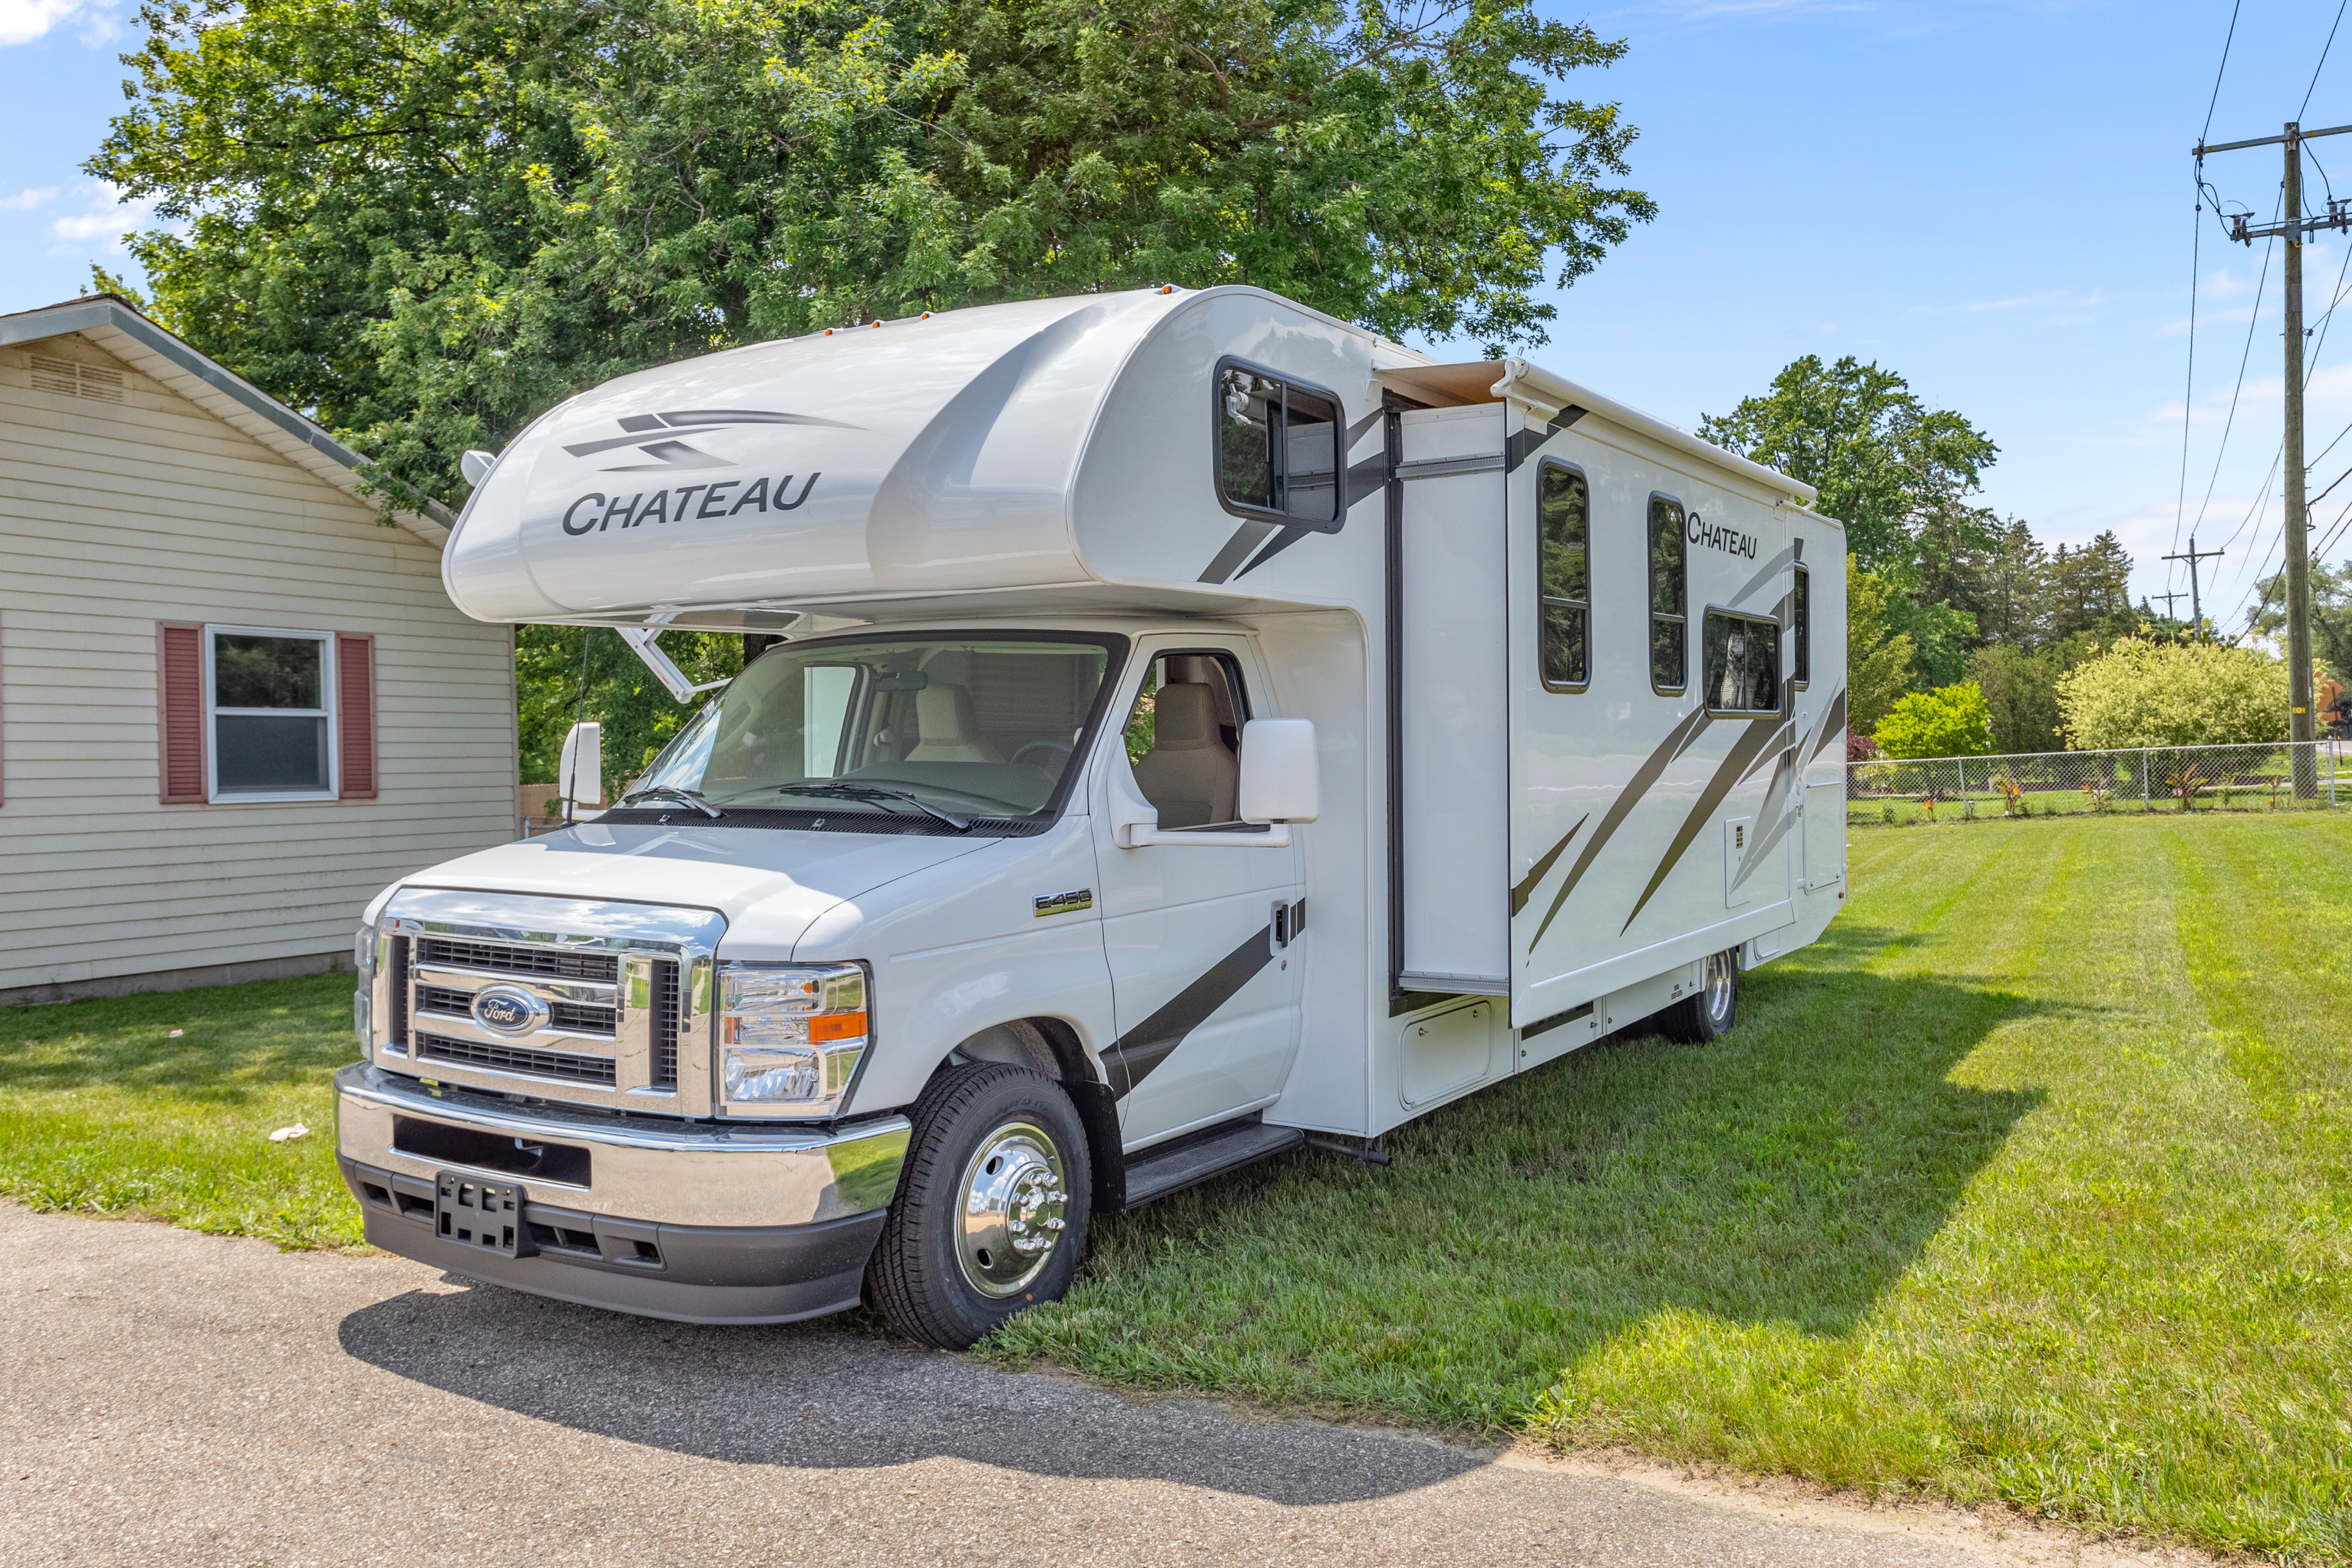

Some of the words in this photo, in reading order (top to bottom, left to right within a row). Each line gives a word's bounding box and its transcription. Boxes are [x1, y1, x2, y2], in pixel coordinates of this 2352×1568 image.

[562, 472, 821, 535] CHATEAU
[1687, 512, 1757, 559] CHATEAU
[484, 999, 515, 1021] Ford
